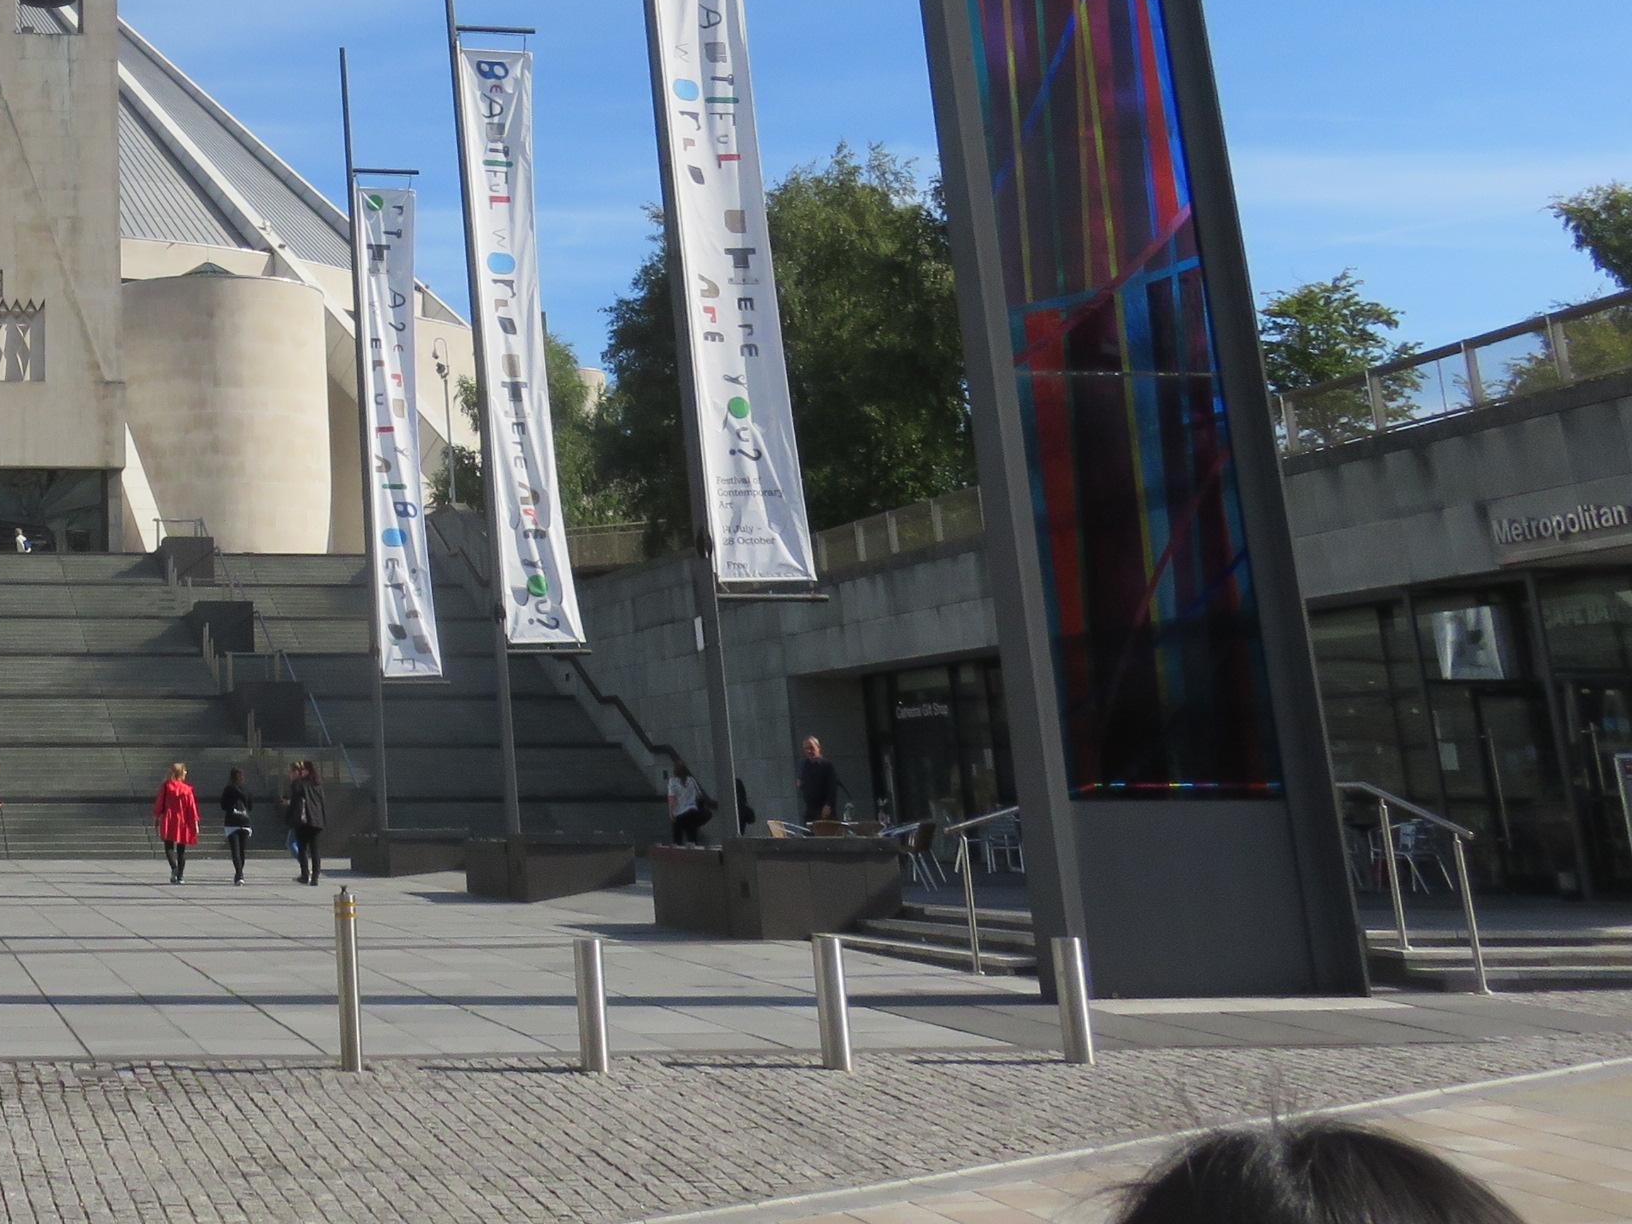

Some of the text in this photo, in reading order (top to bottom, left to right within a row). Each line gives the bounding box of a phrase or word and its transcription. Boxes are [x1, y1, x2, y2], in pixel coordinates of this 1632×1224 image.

[716, 475, 750, 485] Festival
[717, 488, 785, 499] Contemporary
[718, 501, 734, 509] Art
[732, 524, 755, 535] July
[1490, 503, 1629, 546] Metropolitan
[736, 536, 777, 546] October
